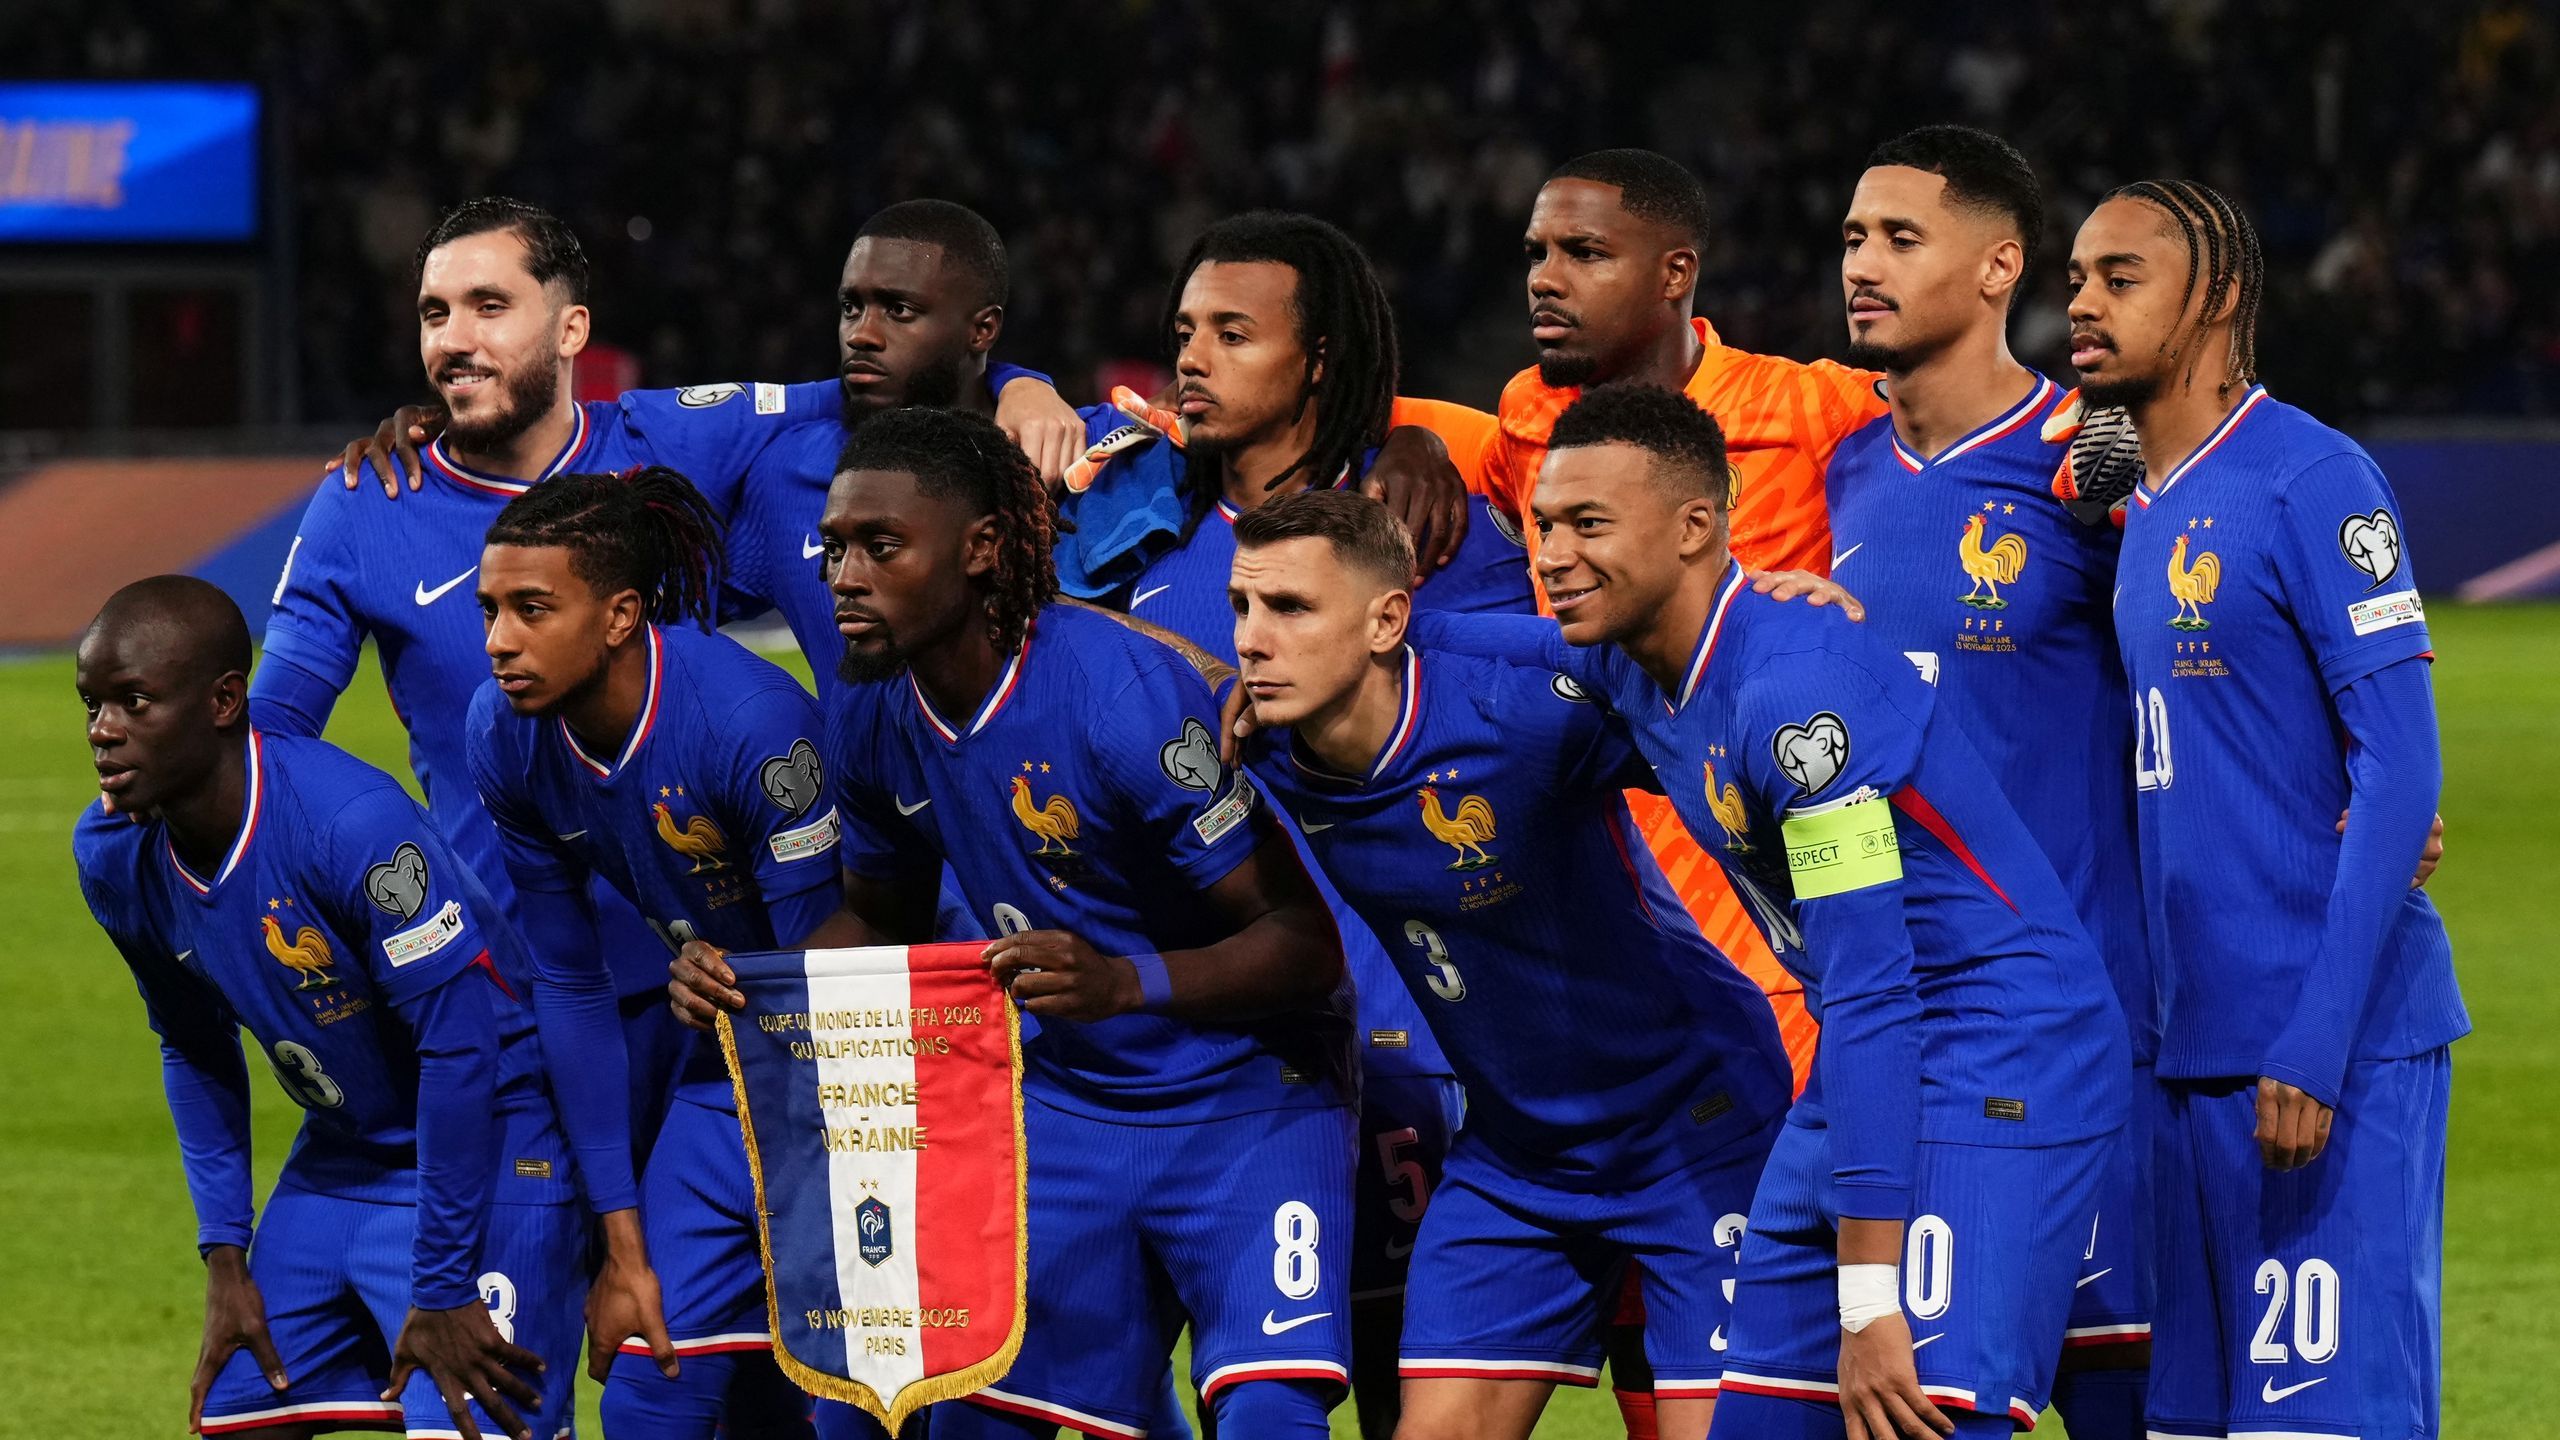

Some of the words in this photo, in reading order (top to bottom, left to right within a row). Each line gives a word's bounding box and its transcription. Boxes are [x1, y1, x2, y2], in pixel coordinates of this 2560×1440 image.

[1965, 618, 1972, 629] F
[1980, 619, 1987, 630] F
[1995, 620, 2003, 631] F
[2353, 602, 2411, 624] FOUNDATION
[1957, 633, 1979, 642] FRANCE
[1996, 644, 2017, 652] 2025
[2176, 641, 2183, 653] F
[2189, 641, 2196, 653] F
[2202, 641, 2210, 653] F
[2172, 669, 2179, 678] 13
[2208, 667, 2229, 677] 2025
[1200, 792, 1247, 836] FOUNDATION
[773, 829, 830, 853] FOUNDATION
[1882, 831, 1898, 848] RE
[1463, 881, 1472, 891] F
[1479, 877, 1488, 887] F
[1494, 872, 1503, 882] F
[388, 928, 443, 957] FOUNDATION
[440, 911, 458, 931] 10
[1403, 919, 1467, 1003] 3
[758, 1011, 794, 1033] COUPE
[795, 1011, 810, 1031] DU
[816, 1008, 862, 1031] MONDE
[866, 1009, 883, 1028] DE
[886, 1008, 904, 1028] LA
[910, 1007, 940, 1027] FIFA
[944, 1006, 982, 1026] 2026
[789, 1035, 951, 1060] QUALIFICATIONS
[816, 1081, 921, 1109] FRANCE
[820, 1126, 929, 1154] UKRAINE
[1375, 1127, 1431, 1224] 5
[862, 1245, 887, 1254] FRANCE
[1273, 1200, 1320, 1300] 8
[804, 1310, 823, 1330] 13
[827, 1309, 914, 1329] NOVEMBRE
[918, 1308, 970, 1329] 2025
[2250, 1258, 2340, 1364] 20
[865, 1337, 907, 1357] PARIS
